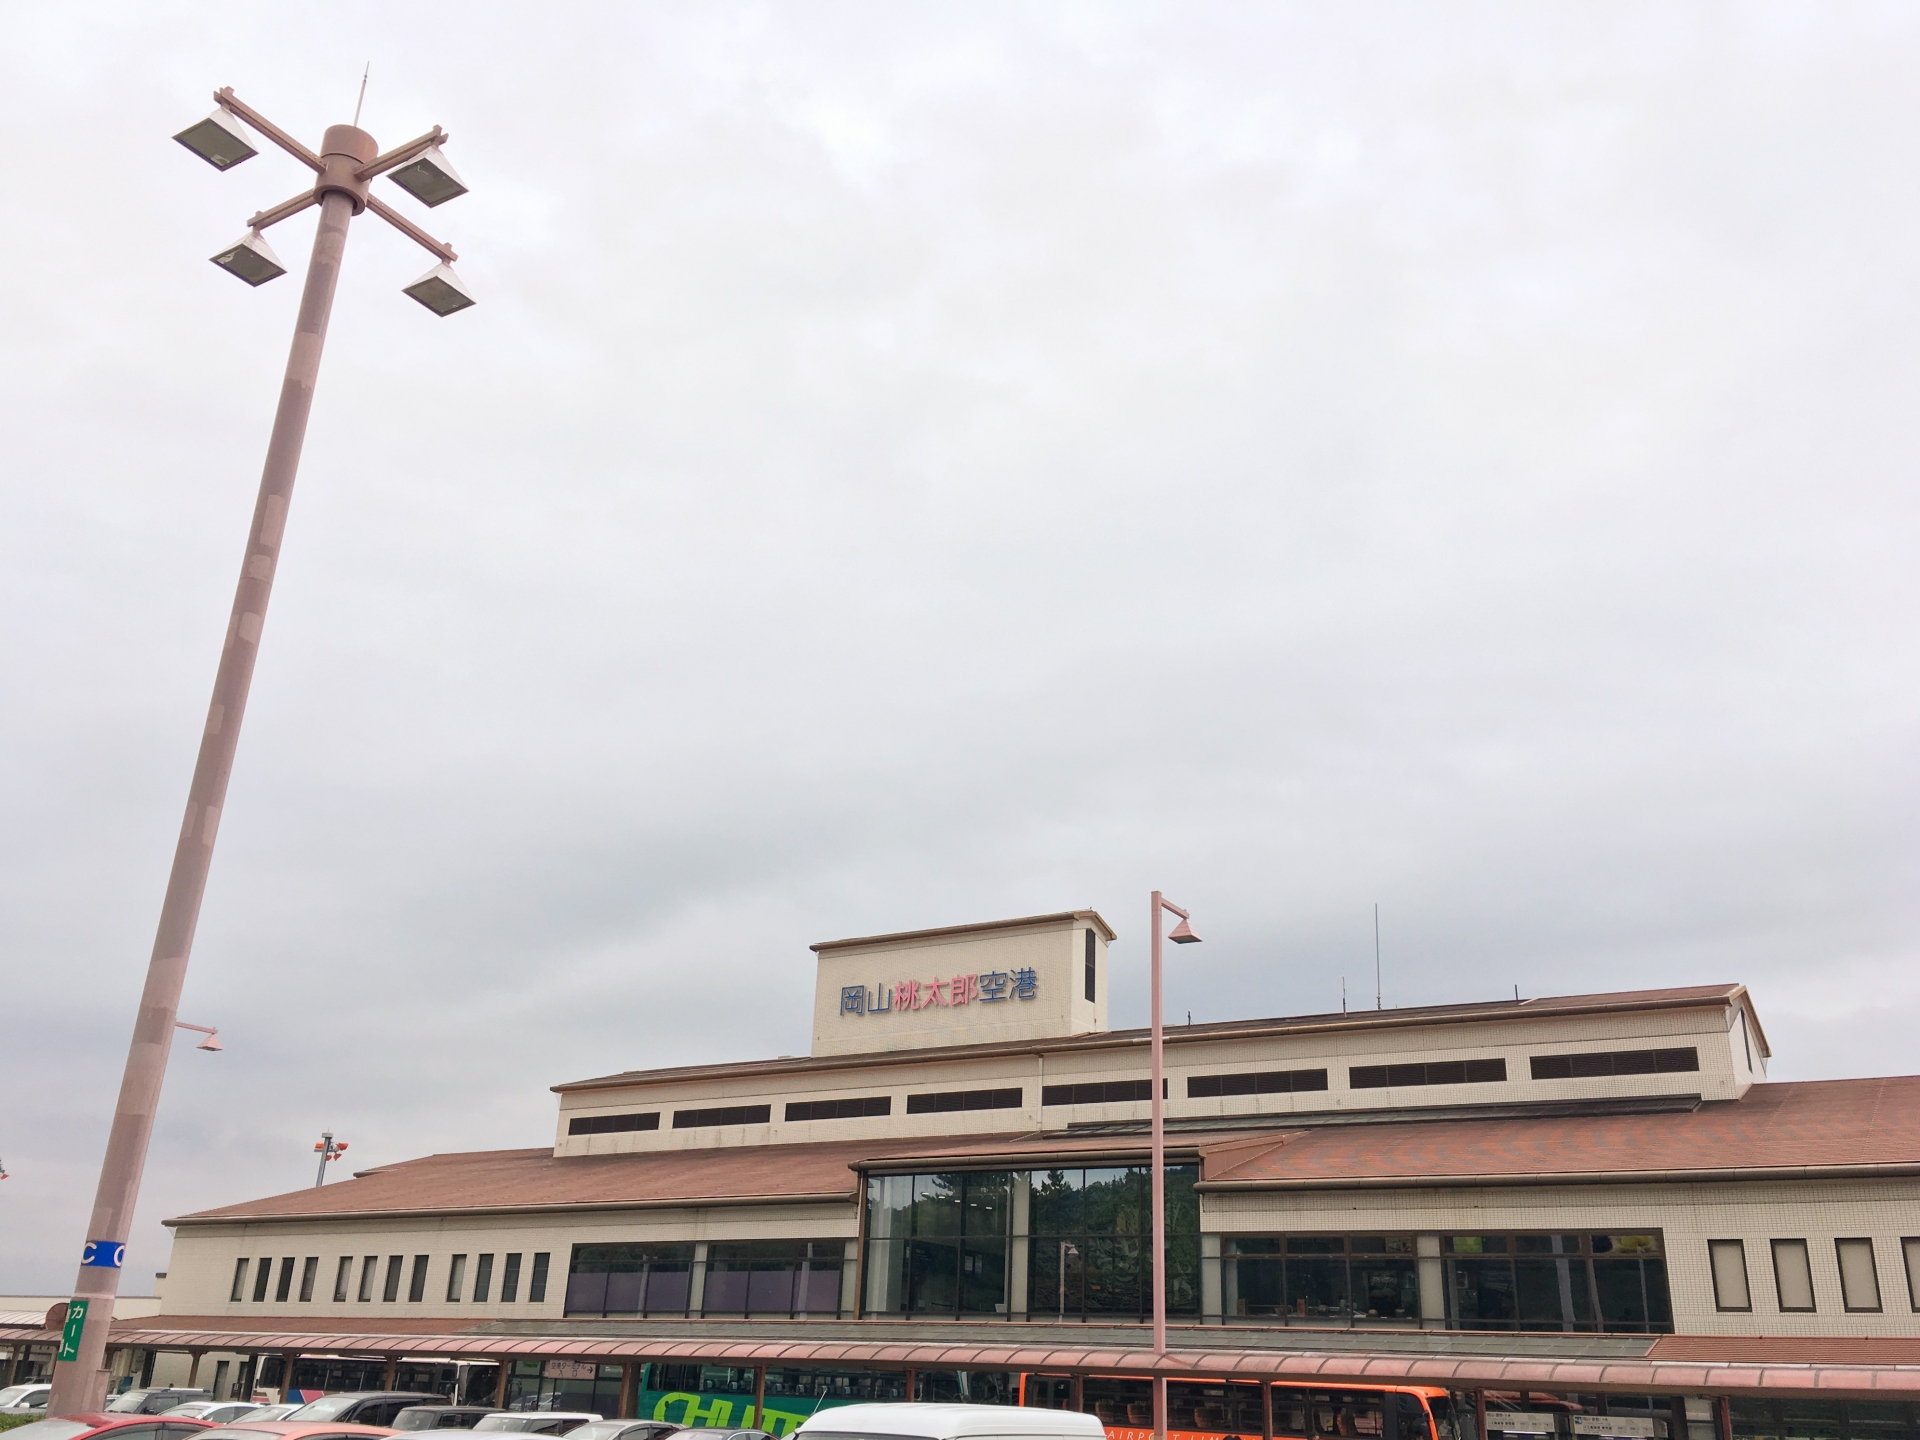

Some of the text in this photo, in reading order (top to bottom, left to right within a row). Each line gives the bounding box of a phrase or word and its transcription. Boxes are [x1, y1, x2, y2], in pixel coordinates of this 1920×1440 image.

[840, 967, 1037, 1016] 岡山桃太郎空港
[63, 1305, 84, 1357] カート
